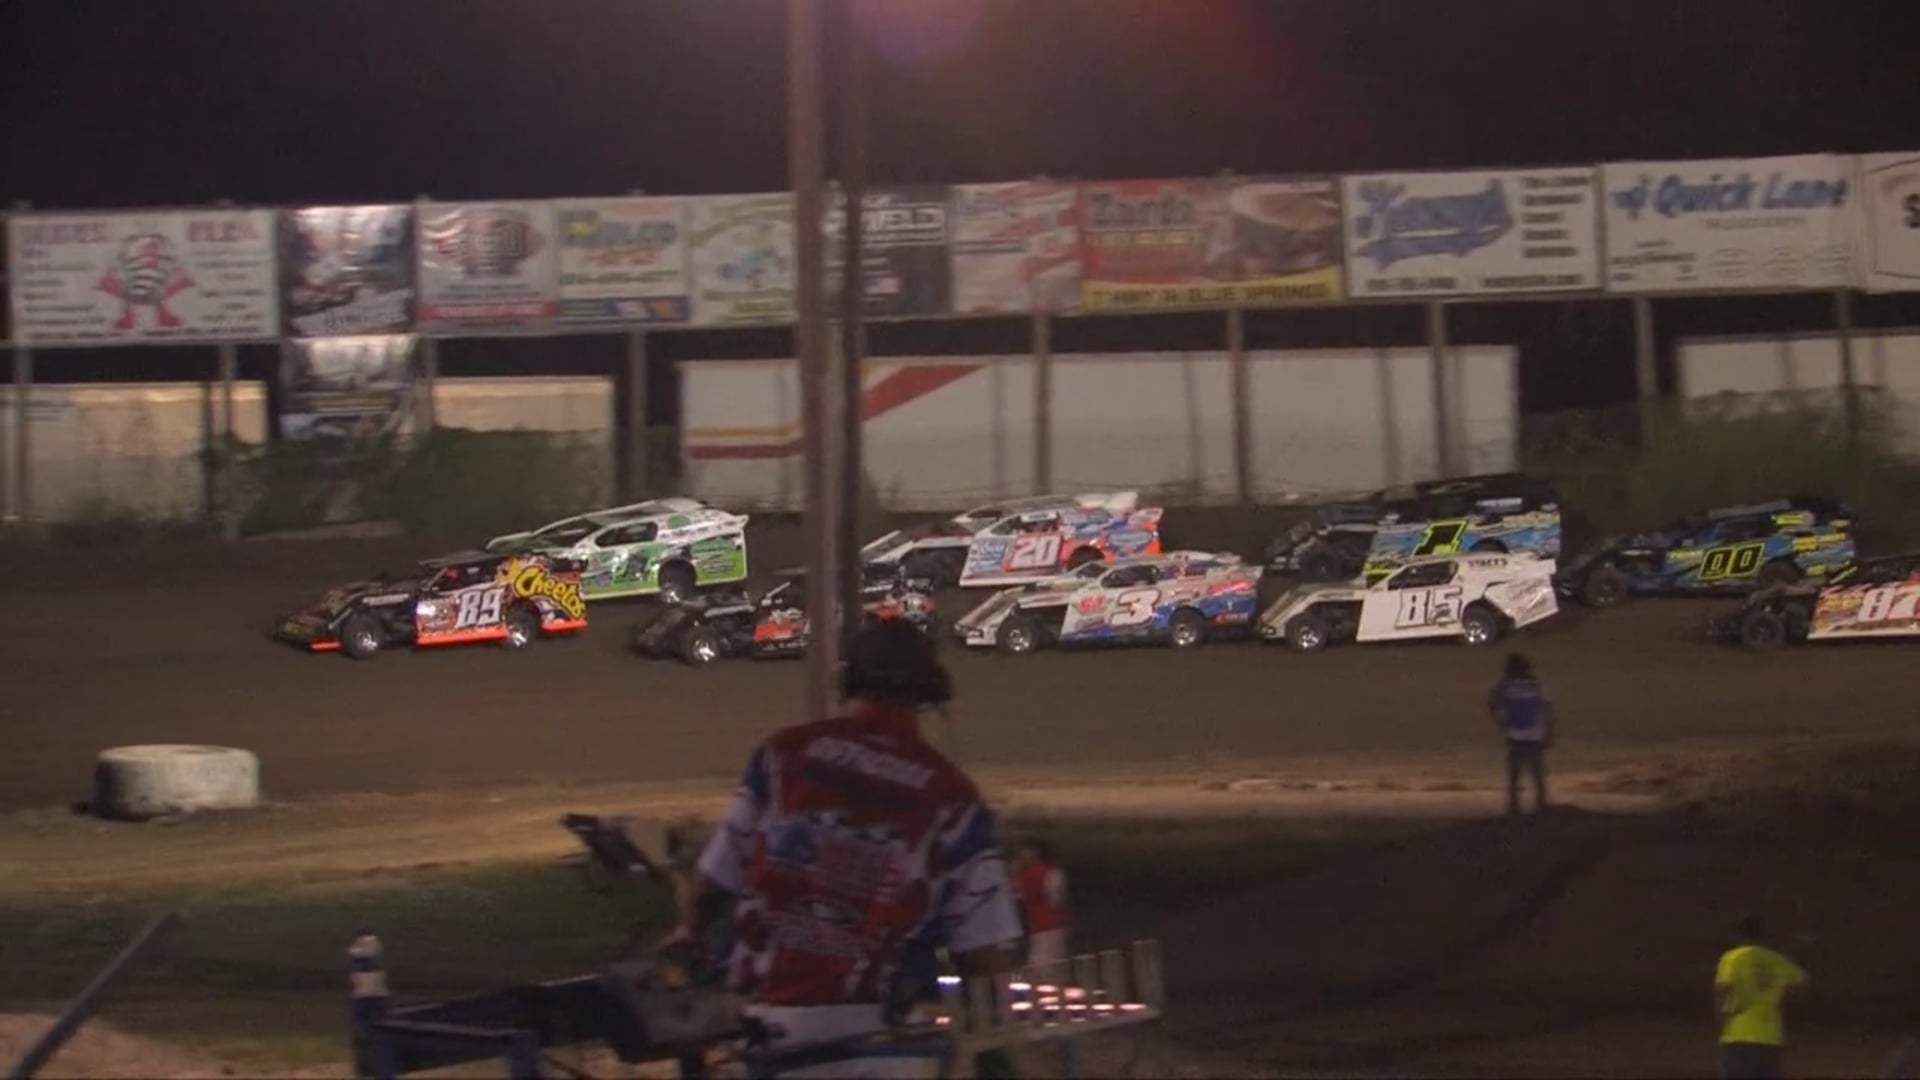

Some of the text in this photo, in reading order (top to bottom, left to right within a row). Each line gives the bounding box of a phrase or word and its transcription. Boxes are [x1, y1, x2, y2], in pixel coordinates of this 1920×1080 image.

[1652, 173, 1757, 217] Quick
[1012, 533, 1062, 568] 20
[1412, 520, 1467, 556] 1
[1700, 544, 1764, 579] 00
[456, 588, 505, 630] 89
[1109, 589, 1161, 628] 3
[1396, 586, 1463, 629] 85
